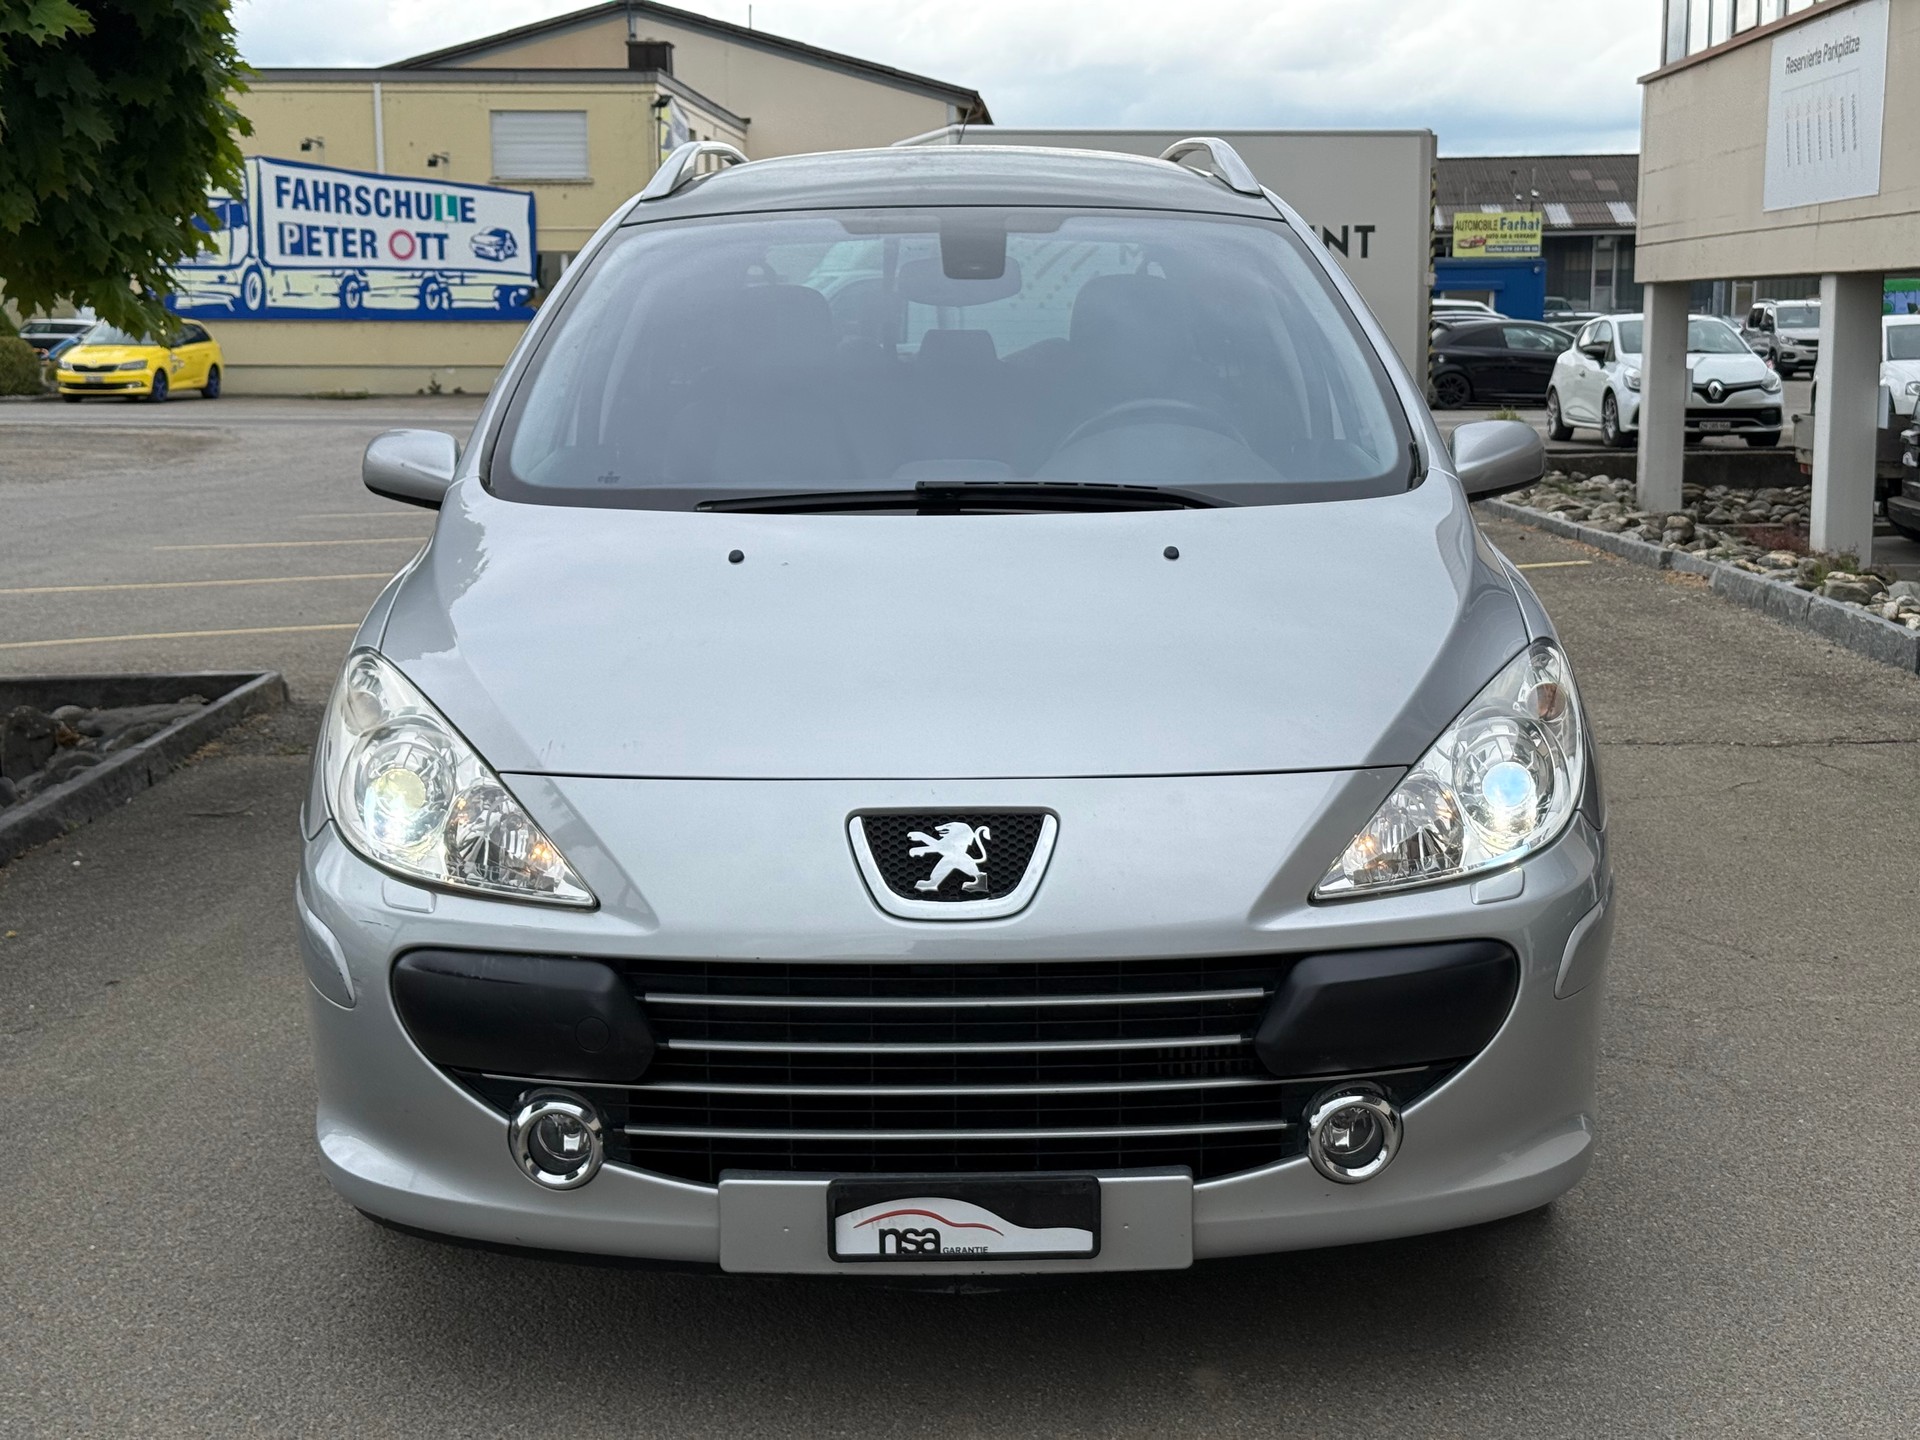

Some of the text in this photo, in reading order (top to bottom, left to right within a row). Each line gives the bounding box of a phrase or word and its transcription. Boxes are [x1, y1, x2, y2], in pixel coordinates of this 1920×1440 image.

[1784, 35, 1860, 74] Reservierte Parkplätze
[275, 174, 477, 223] FAHRSCHULE
[278, 221, 450, 261] PETER OTT
[1455, 216, 1540, 231] AUTOMOBILE Farhat
[878, 1227, 989, 1254] nsa GARANTIE
